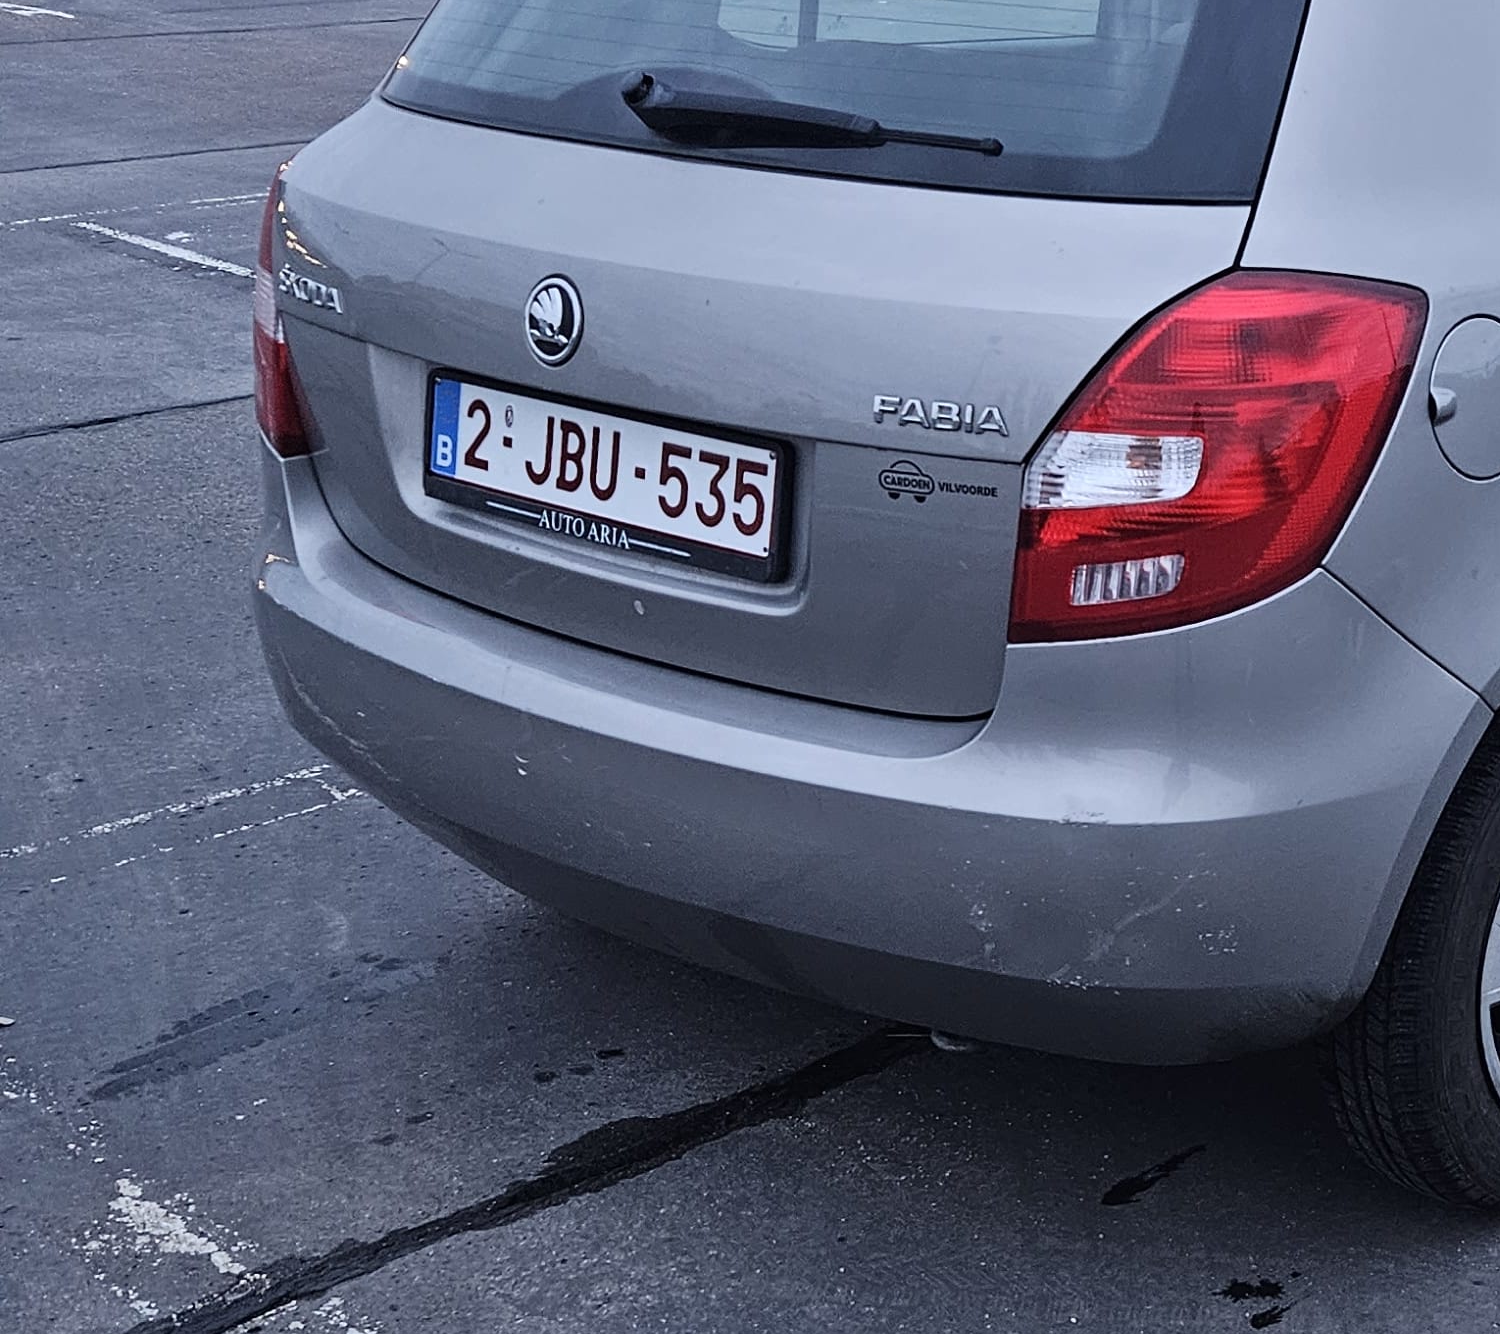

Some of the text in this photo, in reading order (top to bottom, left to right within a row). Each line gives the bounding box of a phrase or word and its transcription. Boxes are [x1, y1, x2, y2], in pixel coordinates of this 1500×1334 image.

[873, 394, 1009, 437] FABIA
[436, 434, 453, 467] B
[883, 474, 998, 498] CARDOEN VILVOORDE
[539, 509, 631, 550] AUTO ARIA
